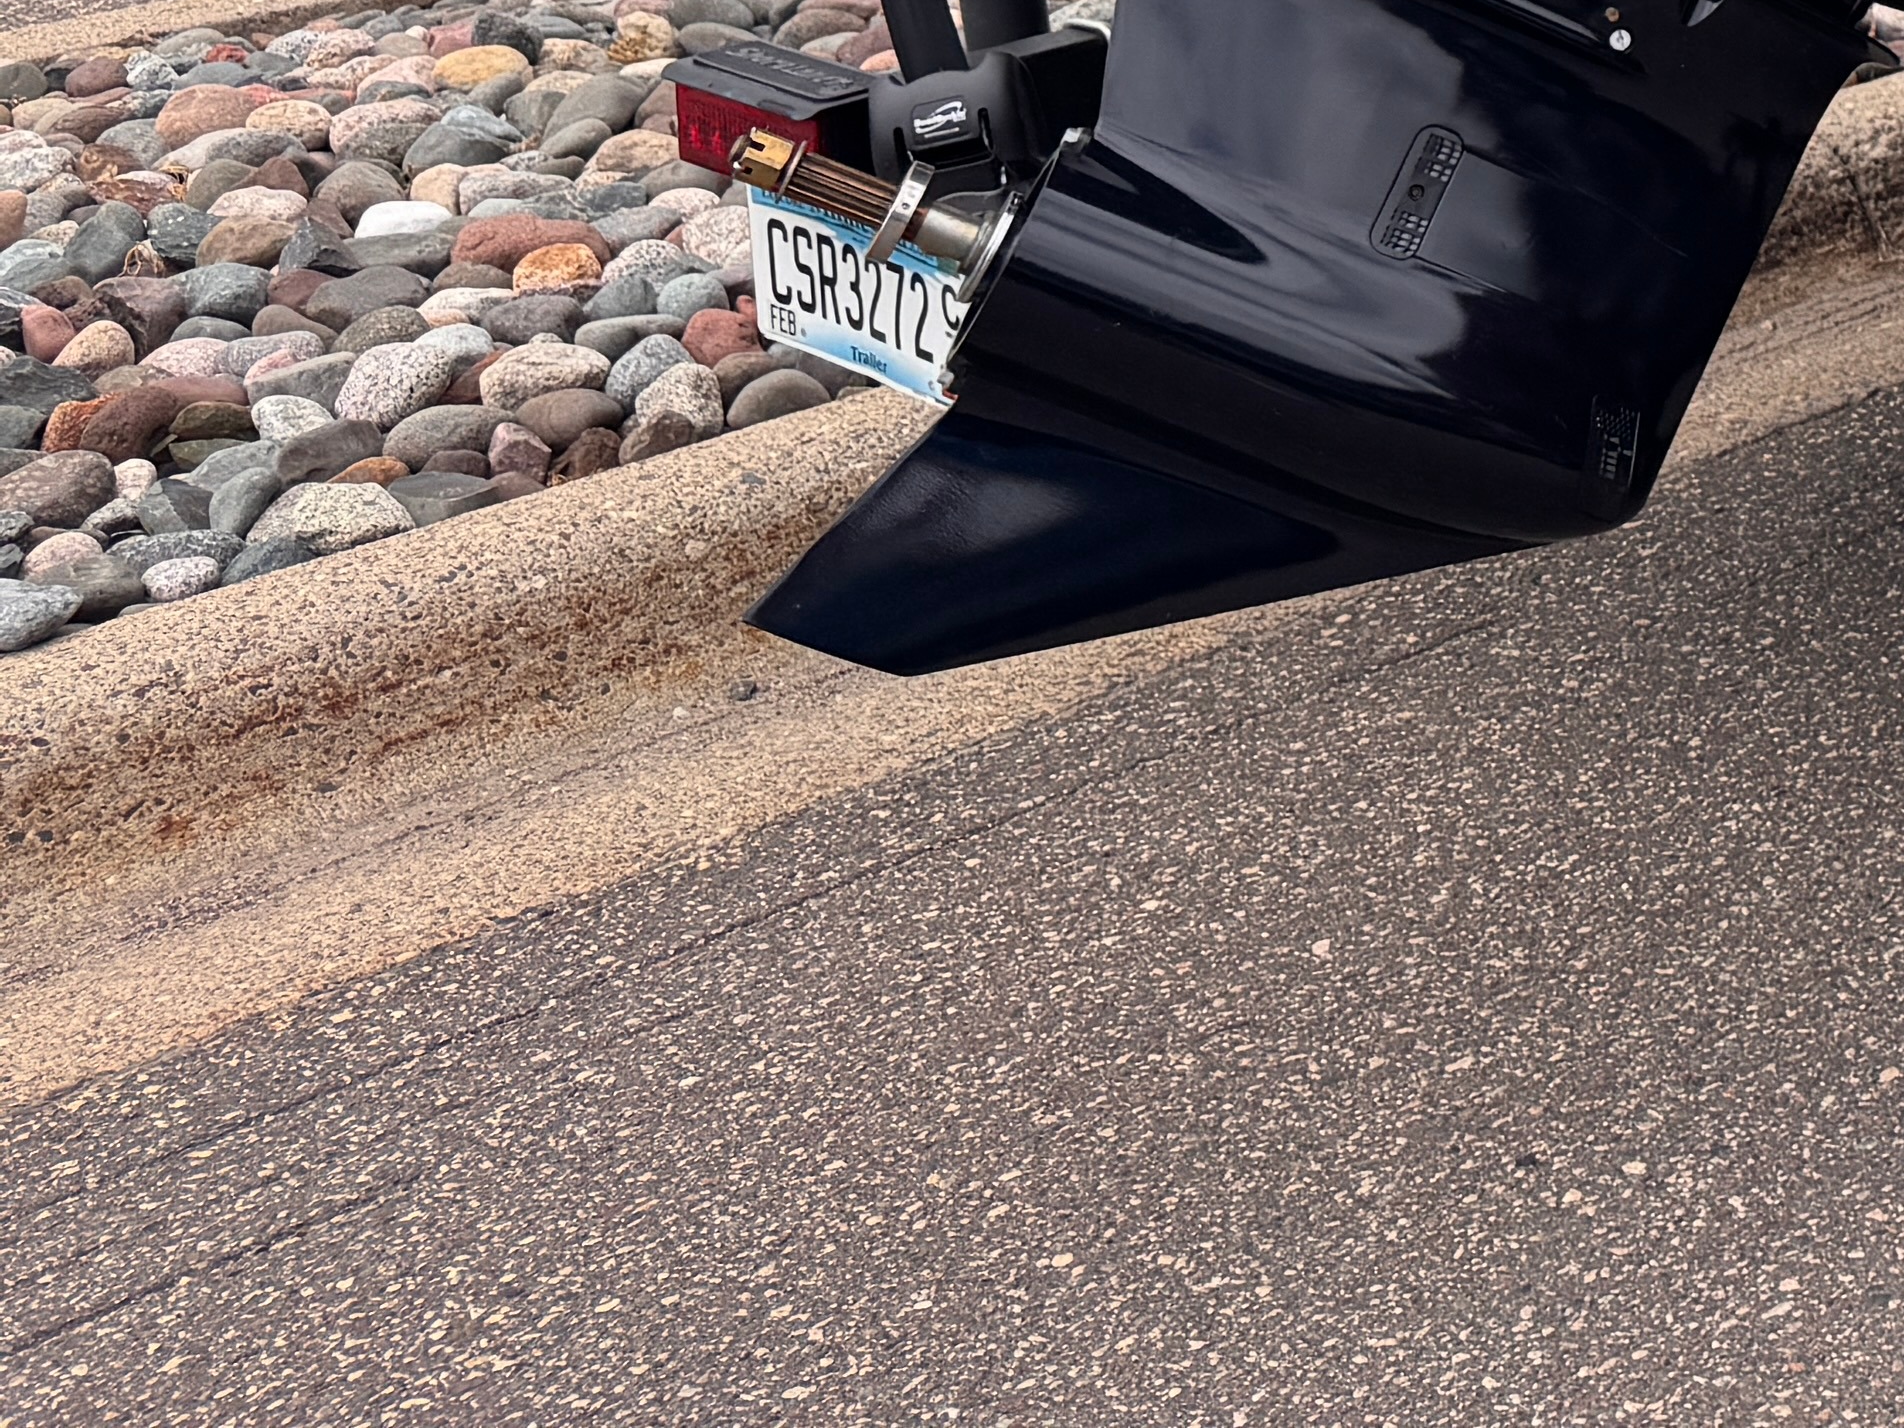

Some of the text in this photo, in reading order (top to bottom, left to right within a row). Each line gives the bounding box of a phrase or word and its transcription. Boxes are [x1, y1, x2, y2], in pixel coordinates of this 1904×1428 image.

[767, 218, 934, 364] CSR3272
[770, 304, 797, 337] FEB
[850, 346, 888, 375] Trailer
